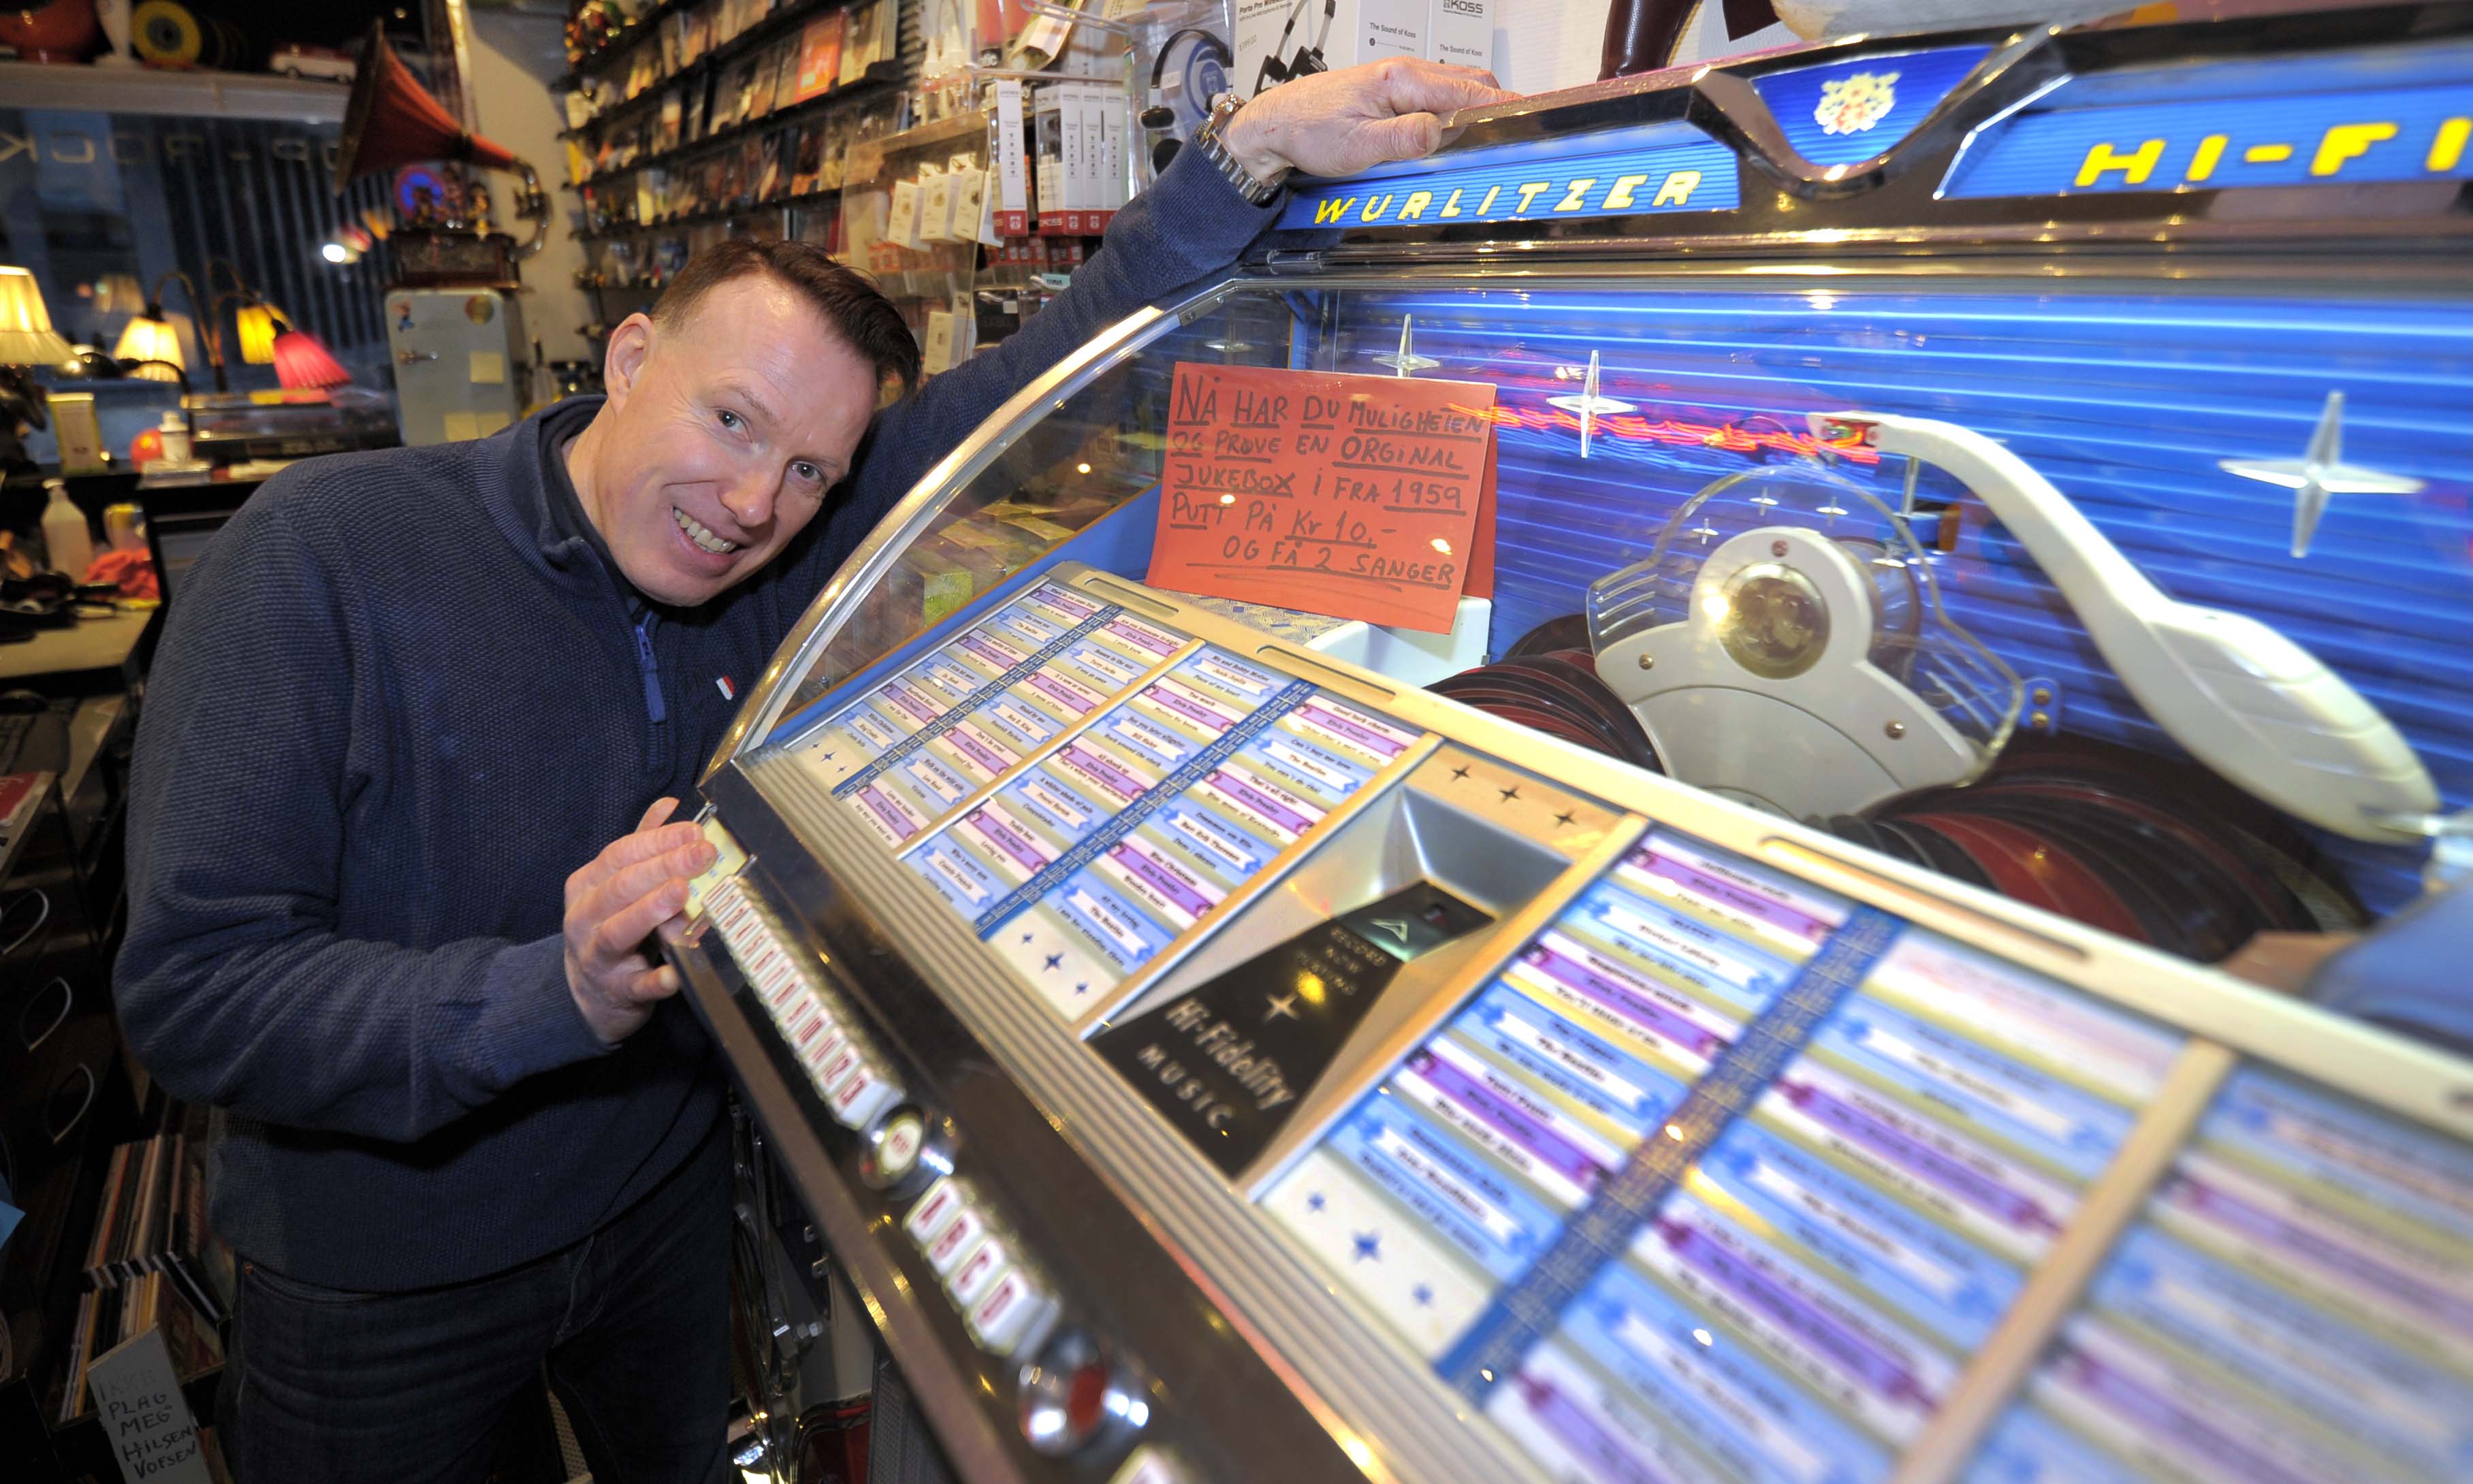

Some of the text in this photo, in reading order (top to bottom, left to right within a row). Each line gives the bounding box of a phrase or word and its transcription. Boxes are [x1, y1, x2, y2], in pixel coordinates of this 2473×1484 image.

[1370, 22, 1379, 31] The
[1381, 25, 1397, 34] Sound
[1451, 0, 1484, 14] KOSS
[1439, 44, 1449, 52] The
[1450, 46, 1465, 54] Sound
[2075, 117, 2473, 187] HI-FI
[1314, 171, 1701, 224] WURLITZER
[1175, 371, 1217, 422] NÅ
[1234, 390, 1289, 425] HAR
[1302, 396, 1340, 422] DU
[1171, 431, 1203, 453] OG
[1215, 430, 1281, 455] PRØVE
[1296, 435, 1329, 455] EN
[1175, 464, 1295, 494] JUKEBOX
[1334, 477, 1380, 502] FRA
[1392, 479, 1462, 509] 1959
[1172, 493, 1231, 526] PUTT
[1246, 501, 1278, 532] PÅ
[1224, 536, 1455, 583] OG FÅ 2 SANGER
[1165, 997, 1293, 1110] Hi-Fidelity
[1137, 1044, 1233, 1129] MUSIC
[959, 1251, 991, 1288] C
